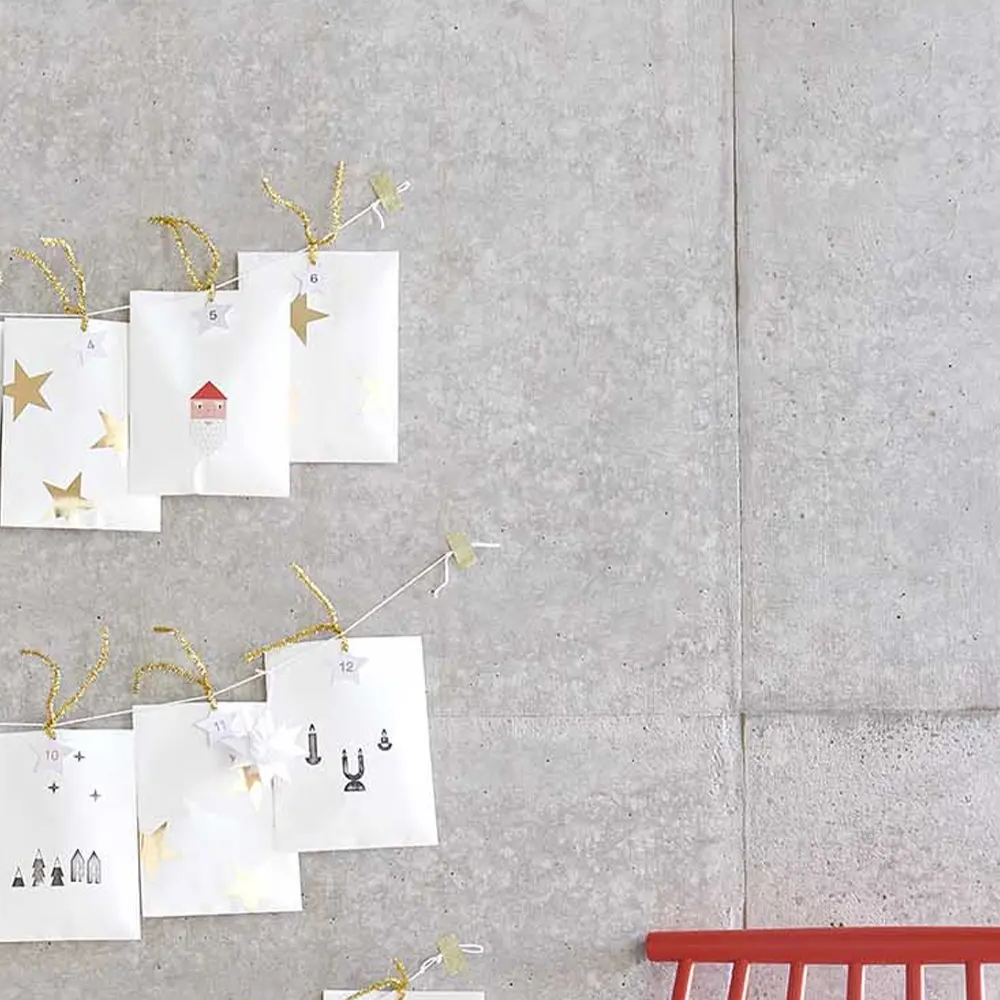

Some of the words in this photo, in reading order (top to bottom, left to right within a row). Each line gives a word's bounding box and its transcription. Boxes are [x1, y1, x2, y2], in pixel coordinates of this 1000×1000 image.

[309, 273, 319, 284] 6
[208, 309, 218, 321] 5
[87, 339, 96, 350] 4
[338, 661, 355, 673] 12
[44, 750, 60, 762] 10
